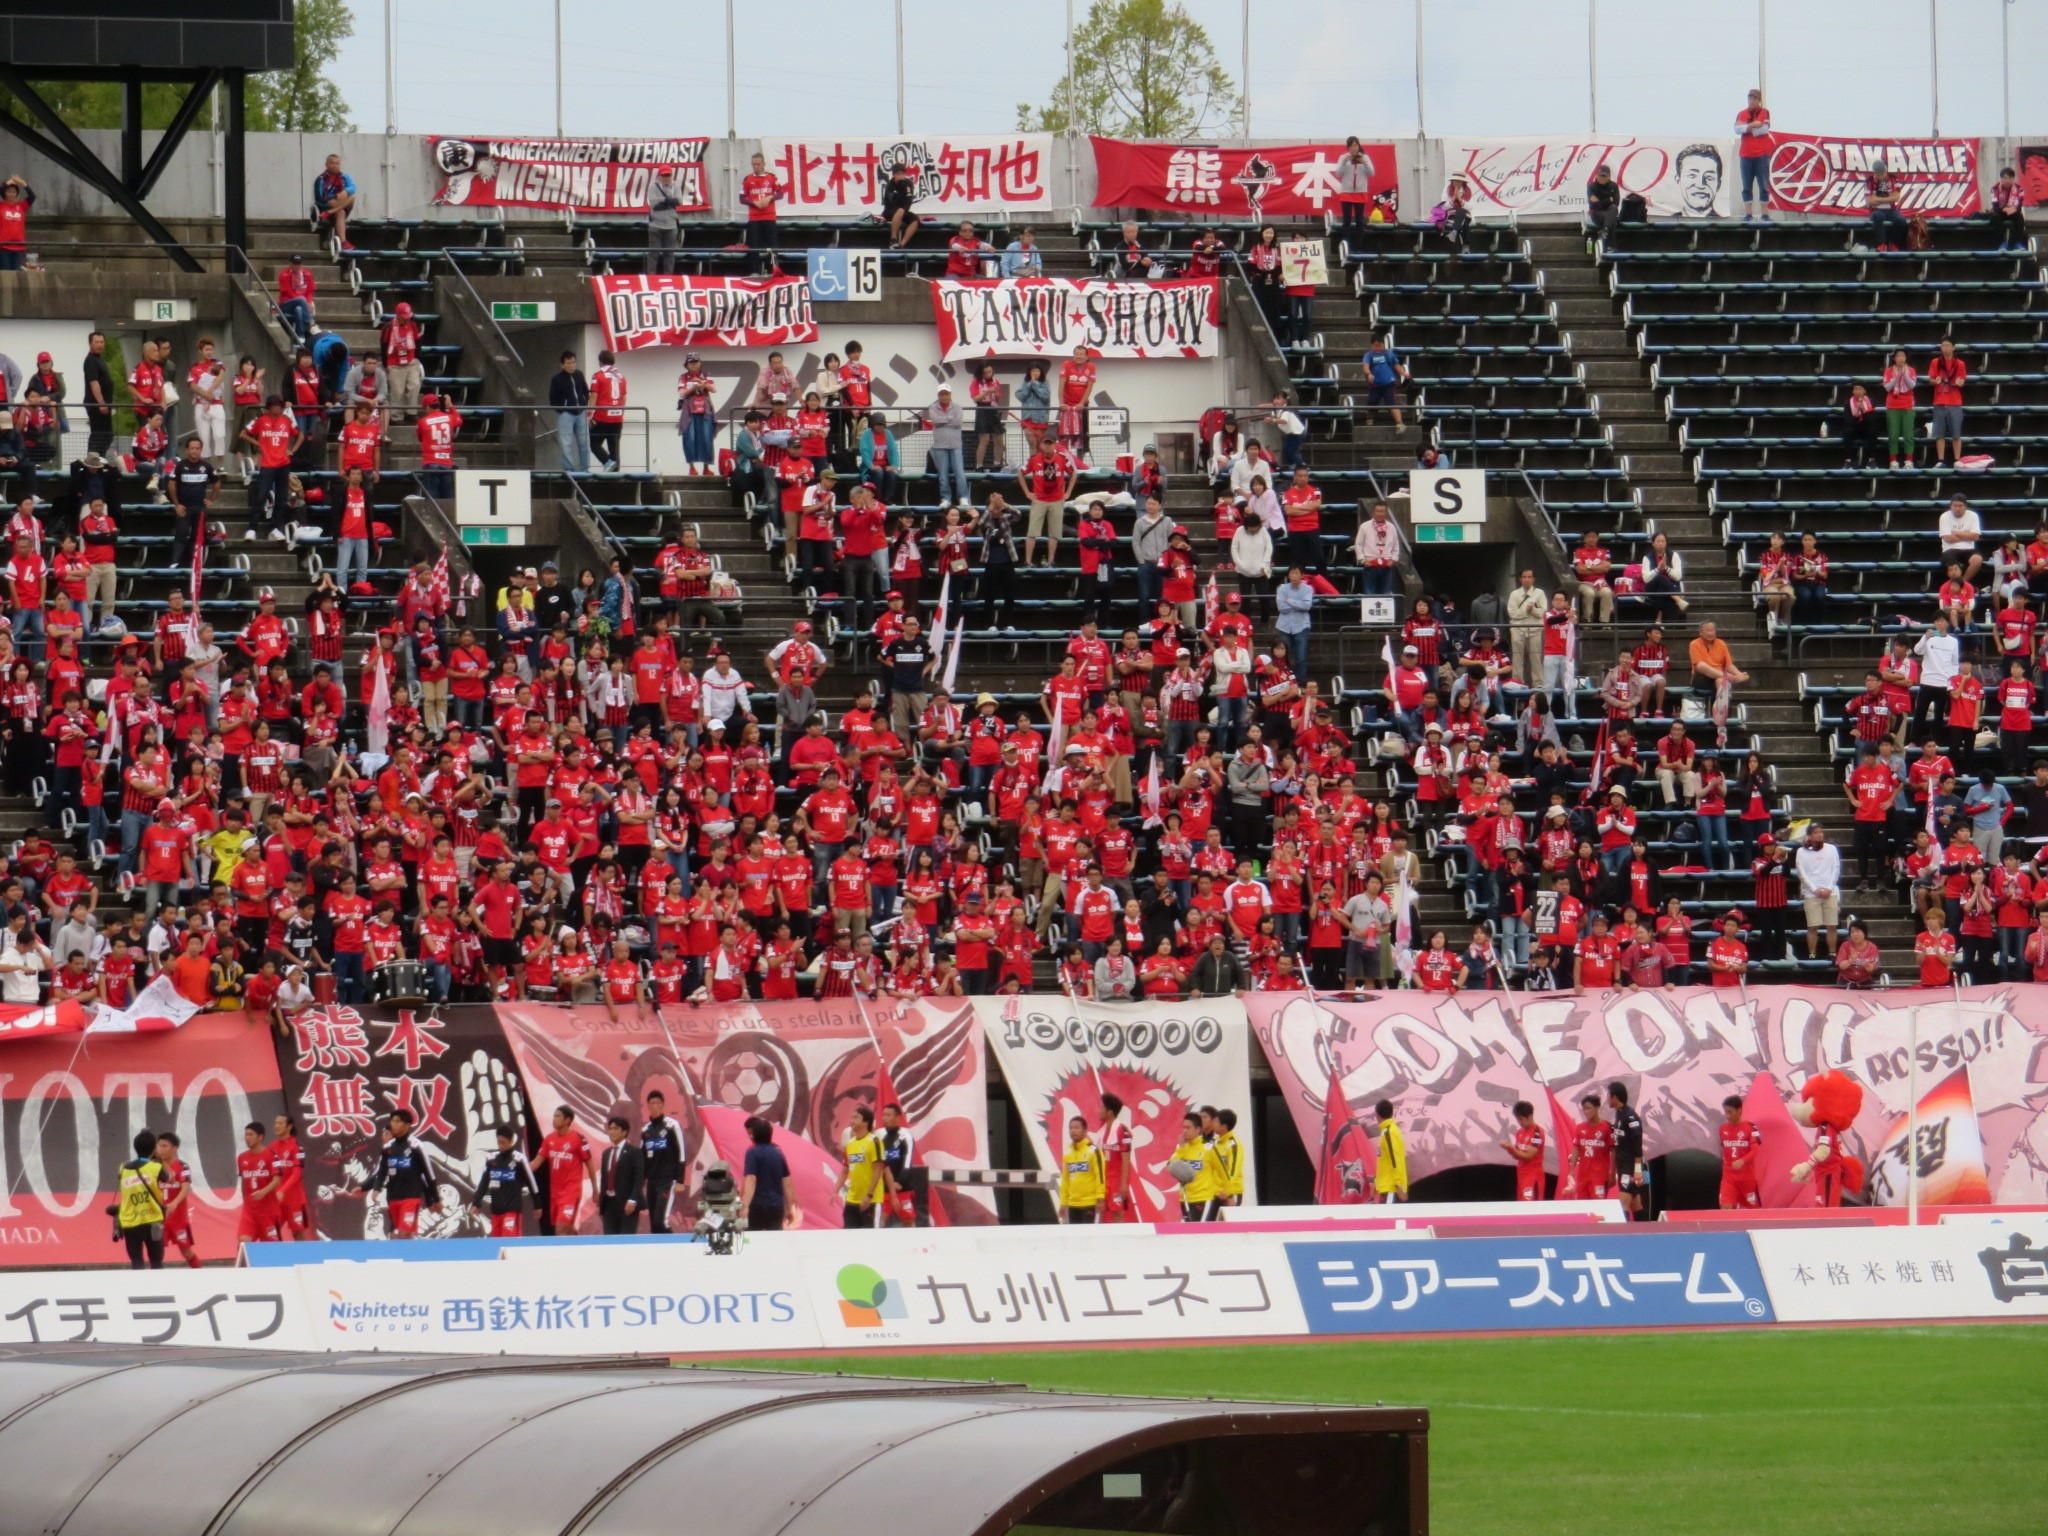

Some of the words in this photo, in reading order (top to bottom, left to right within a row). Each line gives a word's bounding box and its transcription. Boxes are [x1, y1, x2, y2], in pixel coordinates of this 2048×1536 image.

[617, 141, 702, 164] UTEMASU
[494, 161, 608, 209] MISHIMA
[775, 142, 880, 205] 北村
[938, 140, 1044, 203] 知也
[1165, 149, 1223, 205] 熊
[1291, 152, 1342, 208] 本
[850, 255, 878, 294] 15
[1293, 258, 1311, 282] 7
[942, 287, 1070, 346] TAMU
[1086, 288, 1211, 347] SHOW
[479, 479, 508, 516] T
[1433, 477, 1463, 514] S
[789, 1003, 843, 1027] stella
[290, 1005, 450, 1072] 熊本
[1003, 1012, 1223, 1060] 1800000
[1262, 988, 1600, 1104] COME
[302, 1072, 458, 1139] 無双
[1731, 1147, 1737, 1158] 2
[129, 1191, 150, 1206] 002
[1317, 1247, 1745, 1312] シアーズホーム
[1793, 1261, 1957, 1286] 本格米焼酎
[329, 1300, 431, 1319] Nishitetsu
[916, 1265, 1272, 1325] 九州エネコ
[354, 1322, 429, 1333] Group
